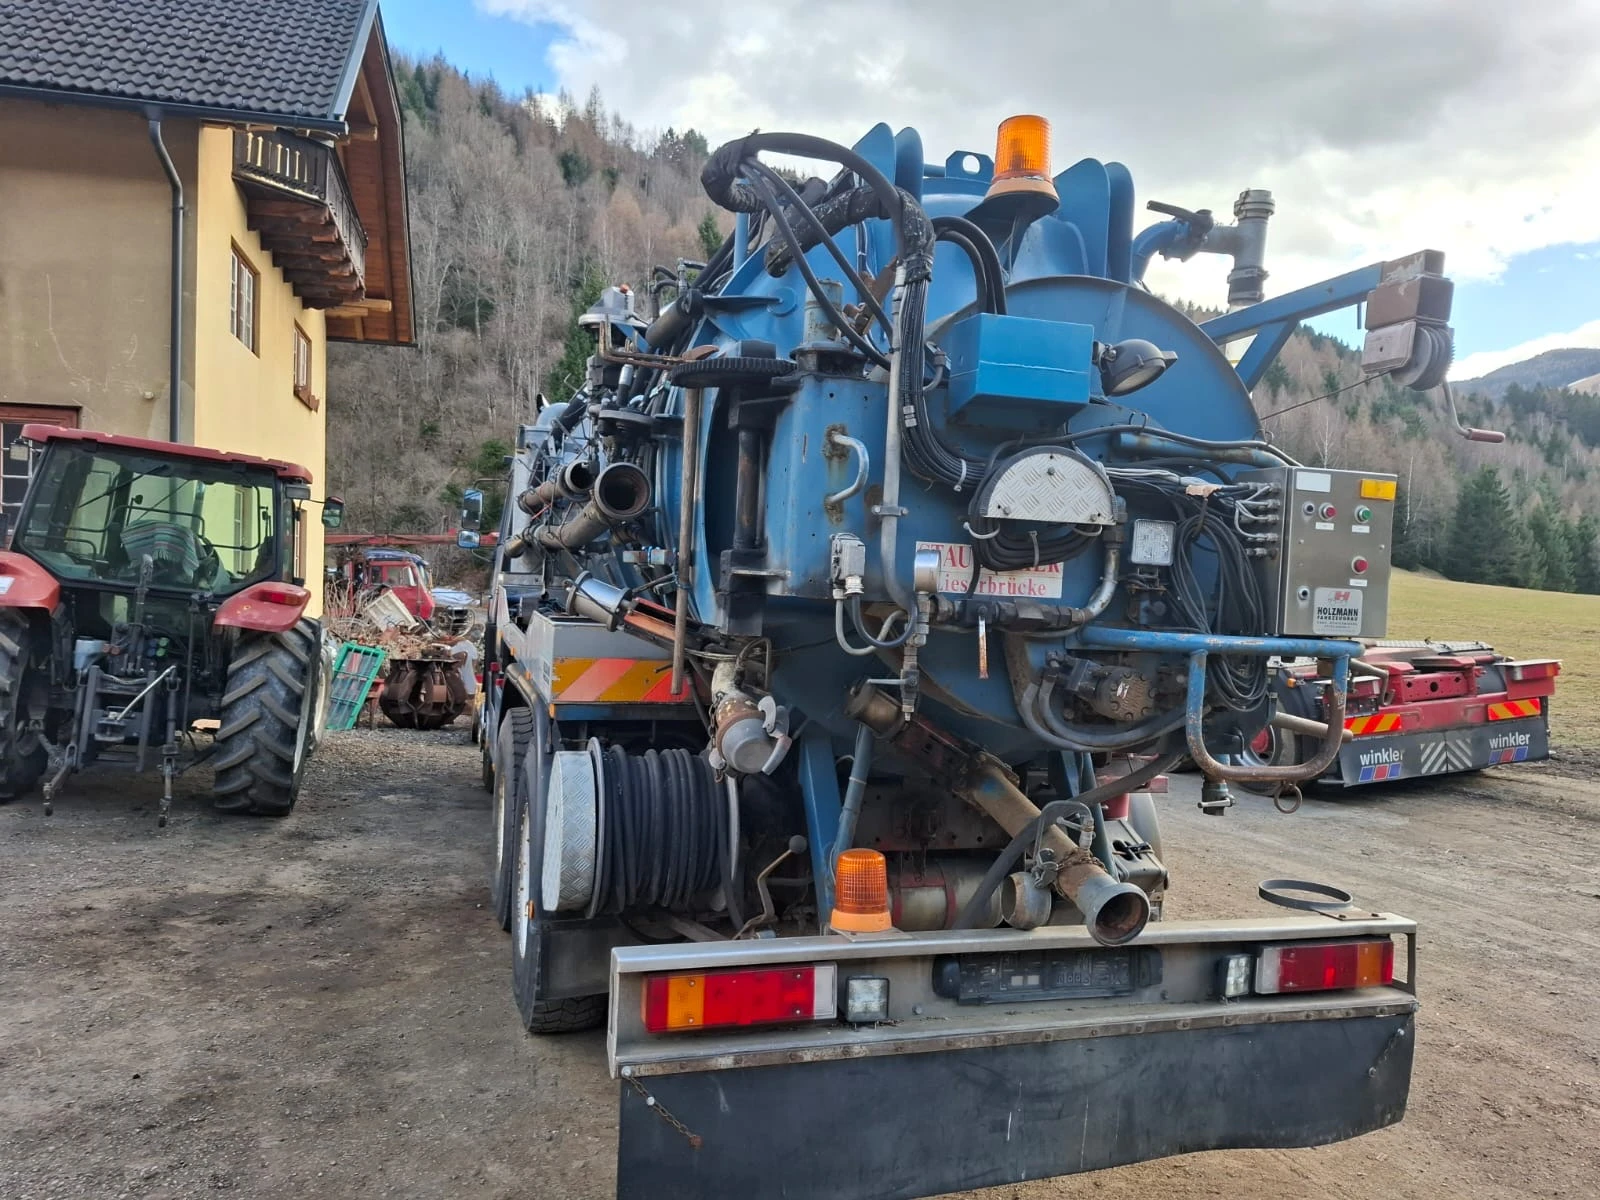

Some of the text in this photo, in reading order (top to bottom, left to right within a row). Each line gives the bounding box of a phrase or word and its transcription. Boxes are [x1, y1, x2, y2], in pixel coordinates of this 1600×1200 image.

[938, 574, 1046, 596] iesrbrücke
[1317, 607, 1358, 617] HOLZMANN
[1489, 731, 1531, 749] winkler
[1360, 748, 1405, 766] winkler
